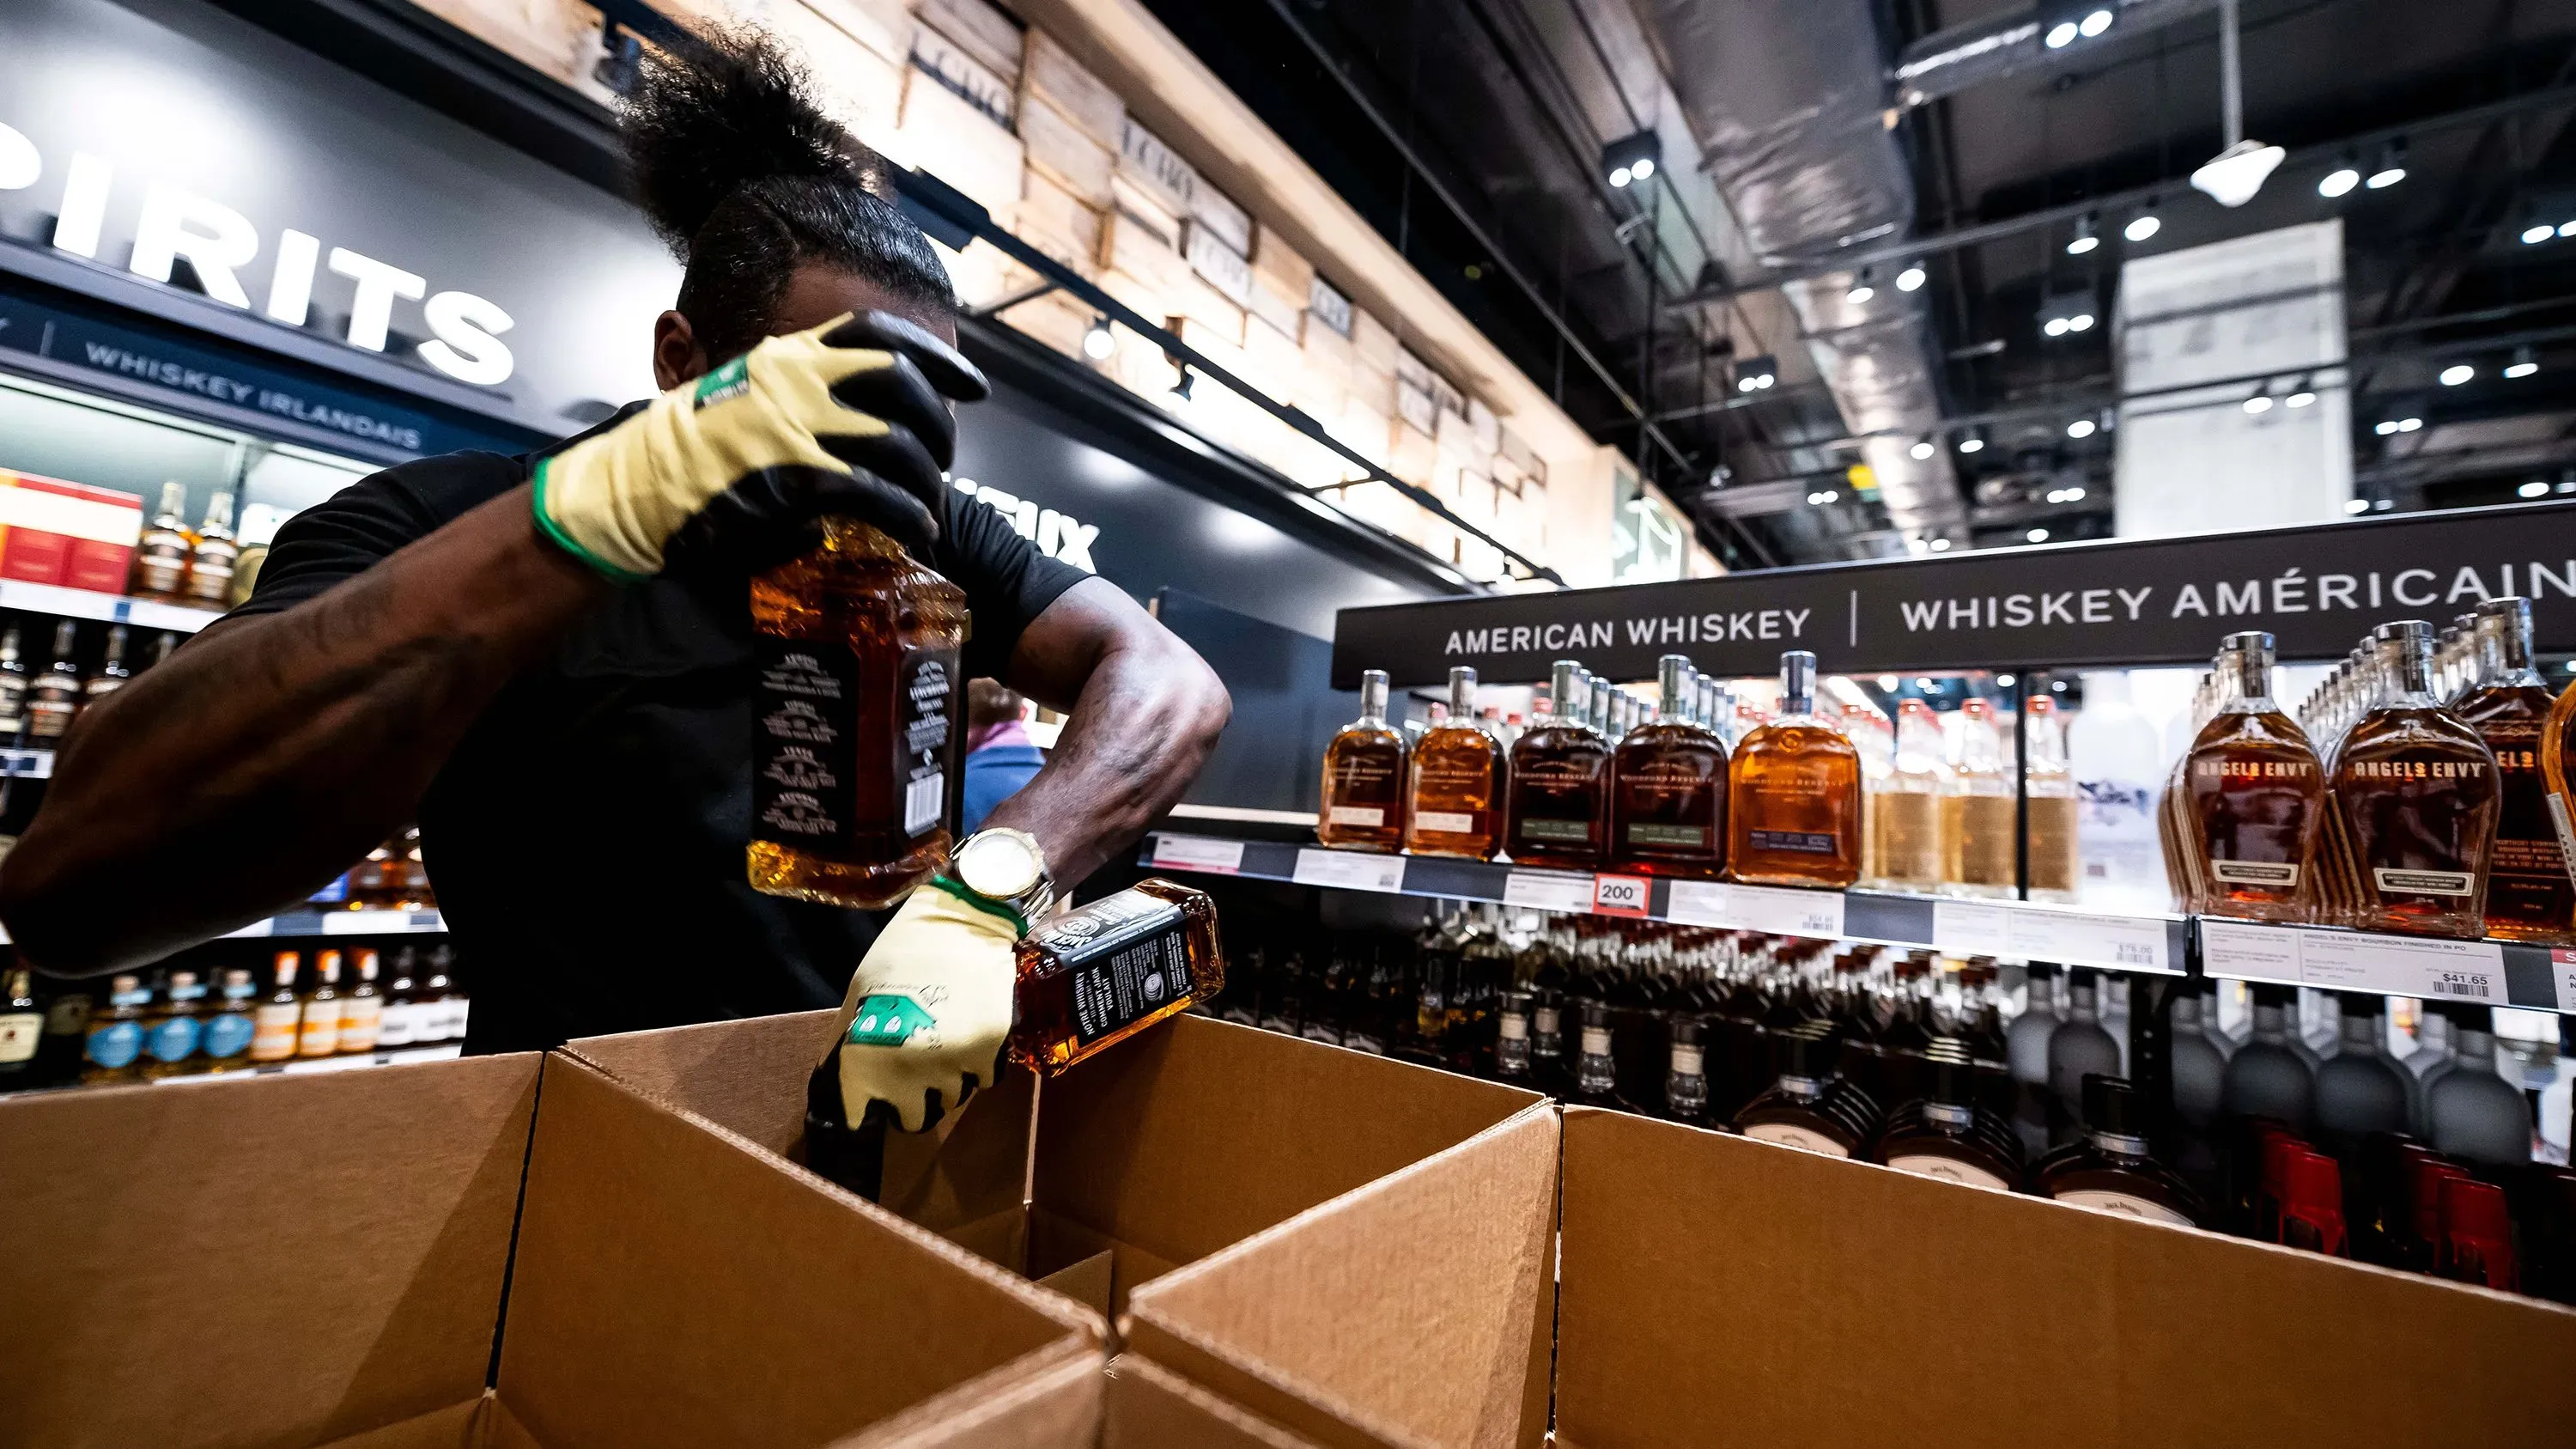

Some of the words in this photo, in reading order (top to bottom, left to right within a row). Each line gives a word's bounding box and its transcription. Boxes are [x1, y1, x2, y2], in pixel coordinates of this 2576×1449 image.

[86, 343, 254, 403] WHISKEY
[258, 390, 422, 450] IRLANDAIS
[1444, 620, 1614, 655] AMERICAN
[1626, 608, 1811, 645] WHISKEY
[1900, 586, 2153, 632] WHISKEY
[2171, 558, 2576, 618] AMÉRICAIN
[2264, 762, 2309, 777] ENVY
[2354, 761, 2427, 778] ANGELS
[2432, 762, 2482, 778] ENVY
[1601, 884, 1634, 900] 200
[1074, 971, 1086, 1010] WHISKEY
[1091, 965, 1102, 989] JACK
[2442, 972, 2488, 985] $41.65
[1094, 987, 1108, 1027] COMMENT
[1101, 976, 1114, 1011] VOULAIT
[1078, 1008, 1095, 1035] NOTRE
